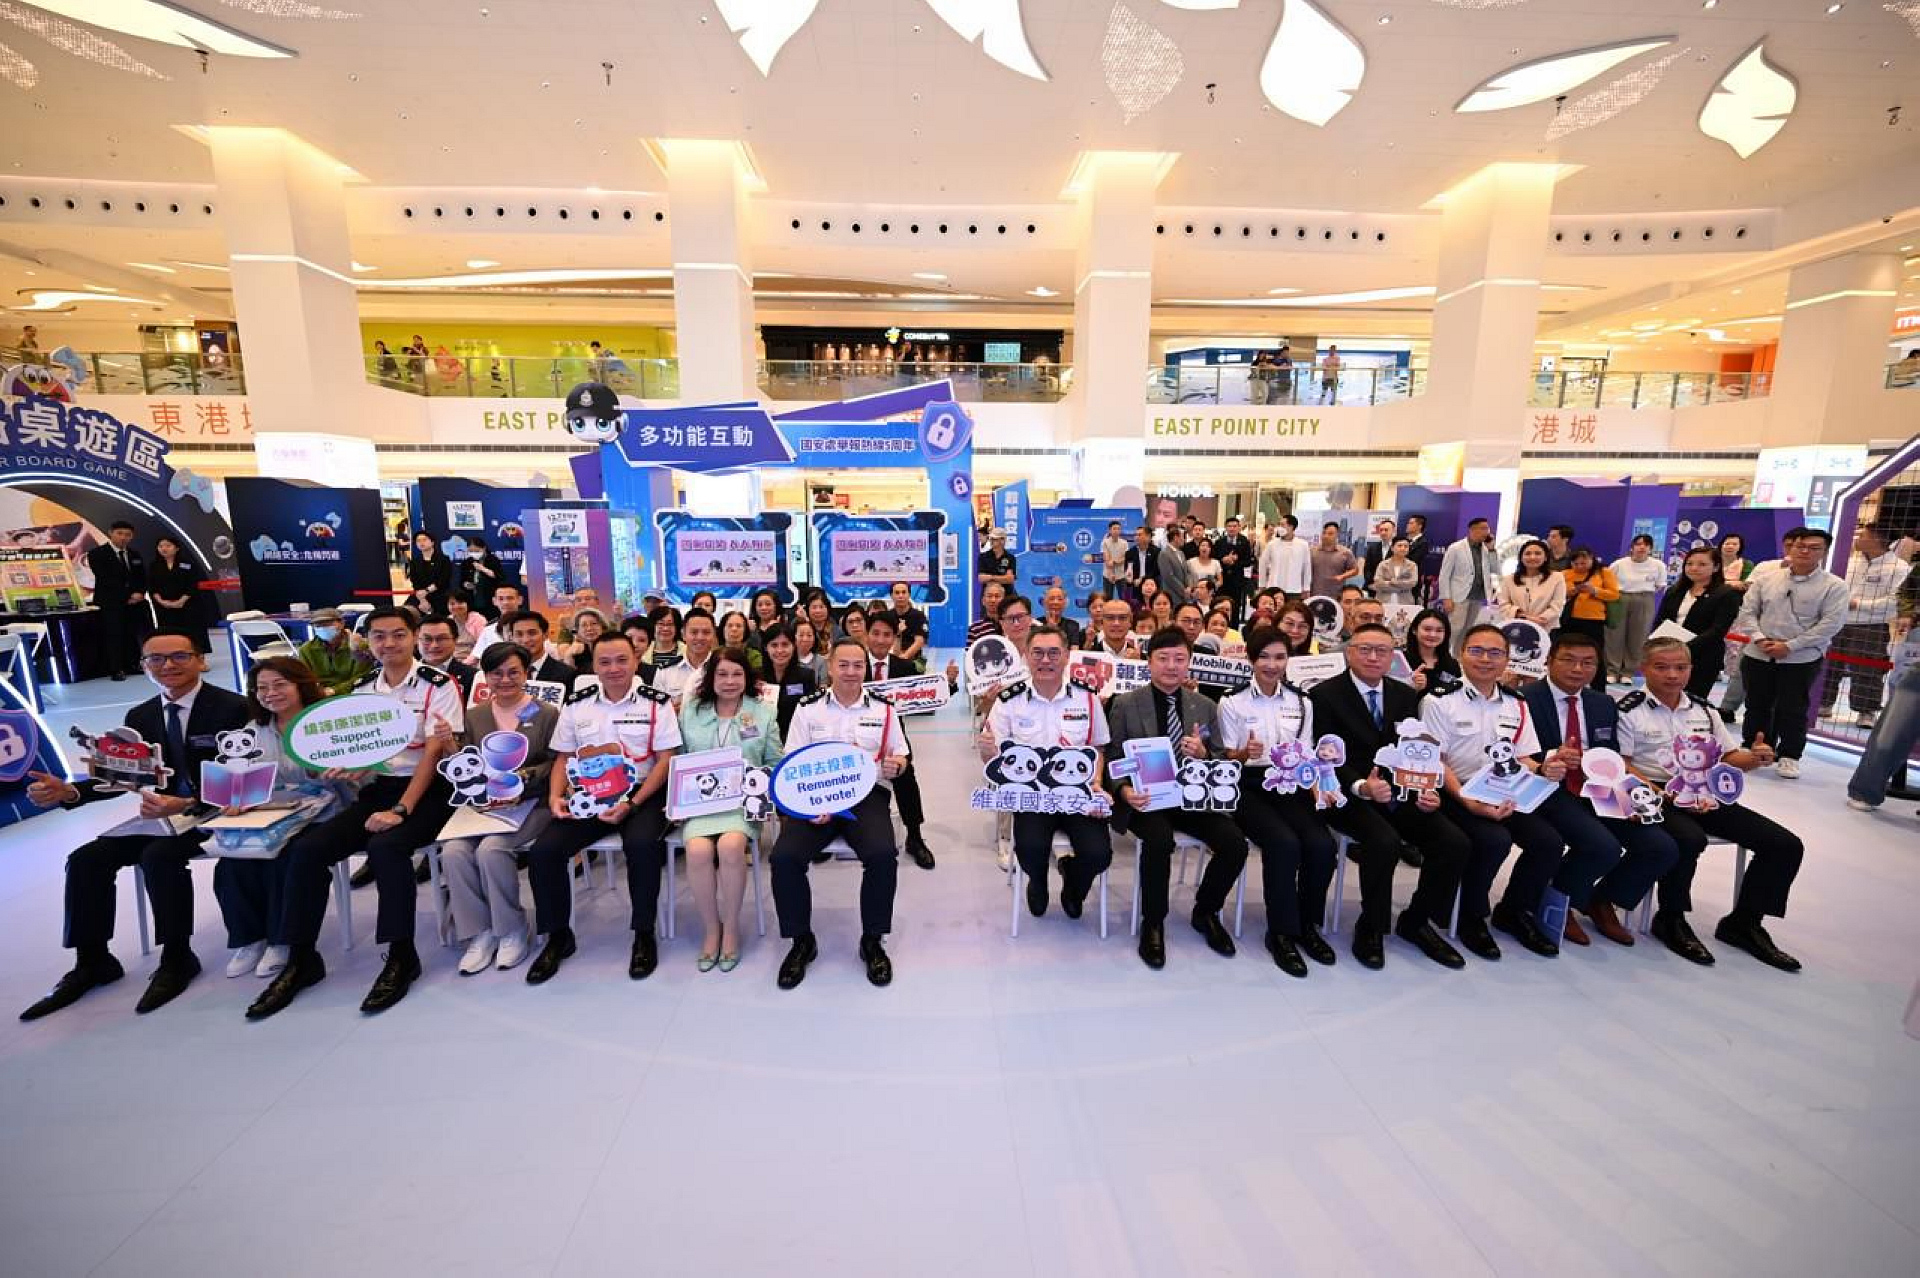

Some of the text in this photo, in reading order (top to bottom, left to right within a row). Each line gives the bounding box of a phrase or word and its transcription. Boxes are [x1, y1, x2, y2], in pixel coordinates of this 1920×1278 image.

[483, 411, 537, 430] EAST
[1153, 418, 1320, 436] EAST POINT CITY
[1532, 414, 1596, 444] 港城
[0, 402, 164, 478] 桌遊區
[640, 426, 753, 446] 多功能互動
[16, 456, 77, 469] BOARD
[83, 463, 127, 480] GAME
[1193, 656, 1232, 669] Mobile
[896, 688, 936, 701] Policing
[329, 727, 383, 744] Support
[309, 734, 409, 760] clean elections!
[797, 772, 862, 792] Remember
[809, 787, 856, 806] to vote!
